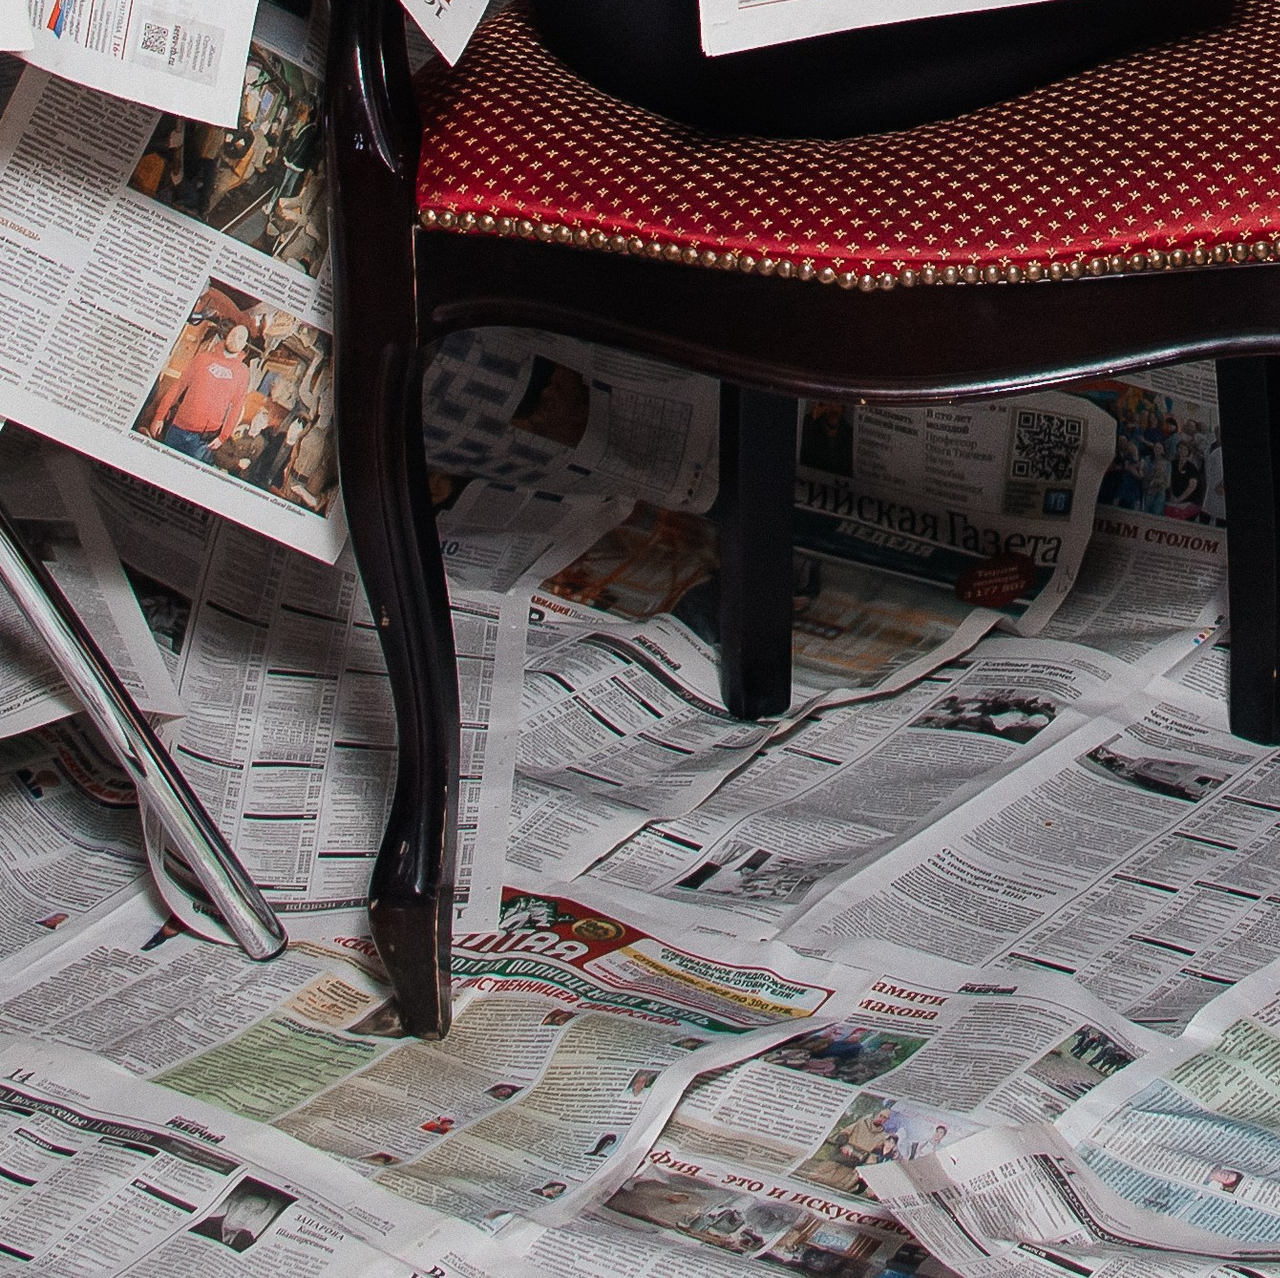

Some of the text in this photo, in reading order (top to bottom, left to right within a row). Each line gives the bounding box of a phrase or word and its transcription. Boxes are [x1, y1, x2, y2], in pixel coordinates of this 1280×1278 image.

[942, 505, 1063, 565] Газета
[1144, 523, 1220, 554] столом
[11, 1094, 88, 1127] воскресенье
